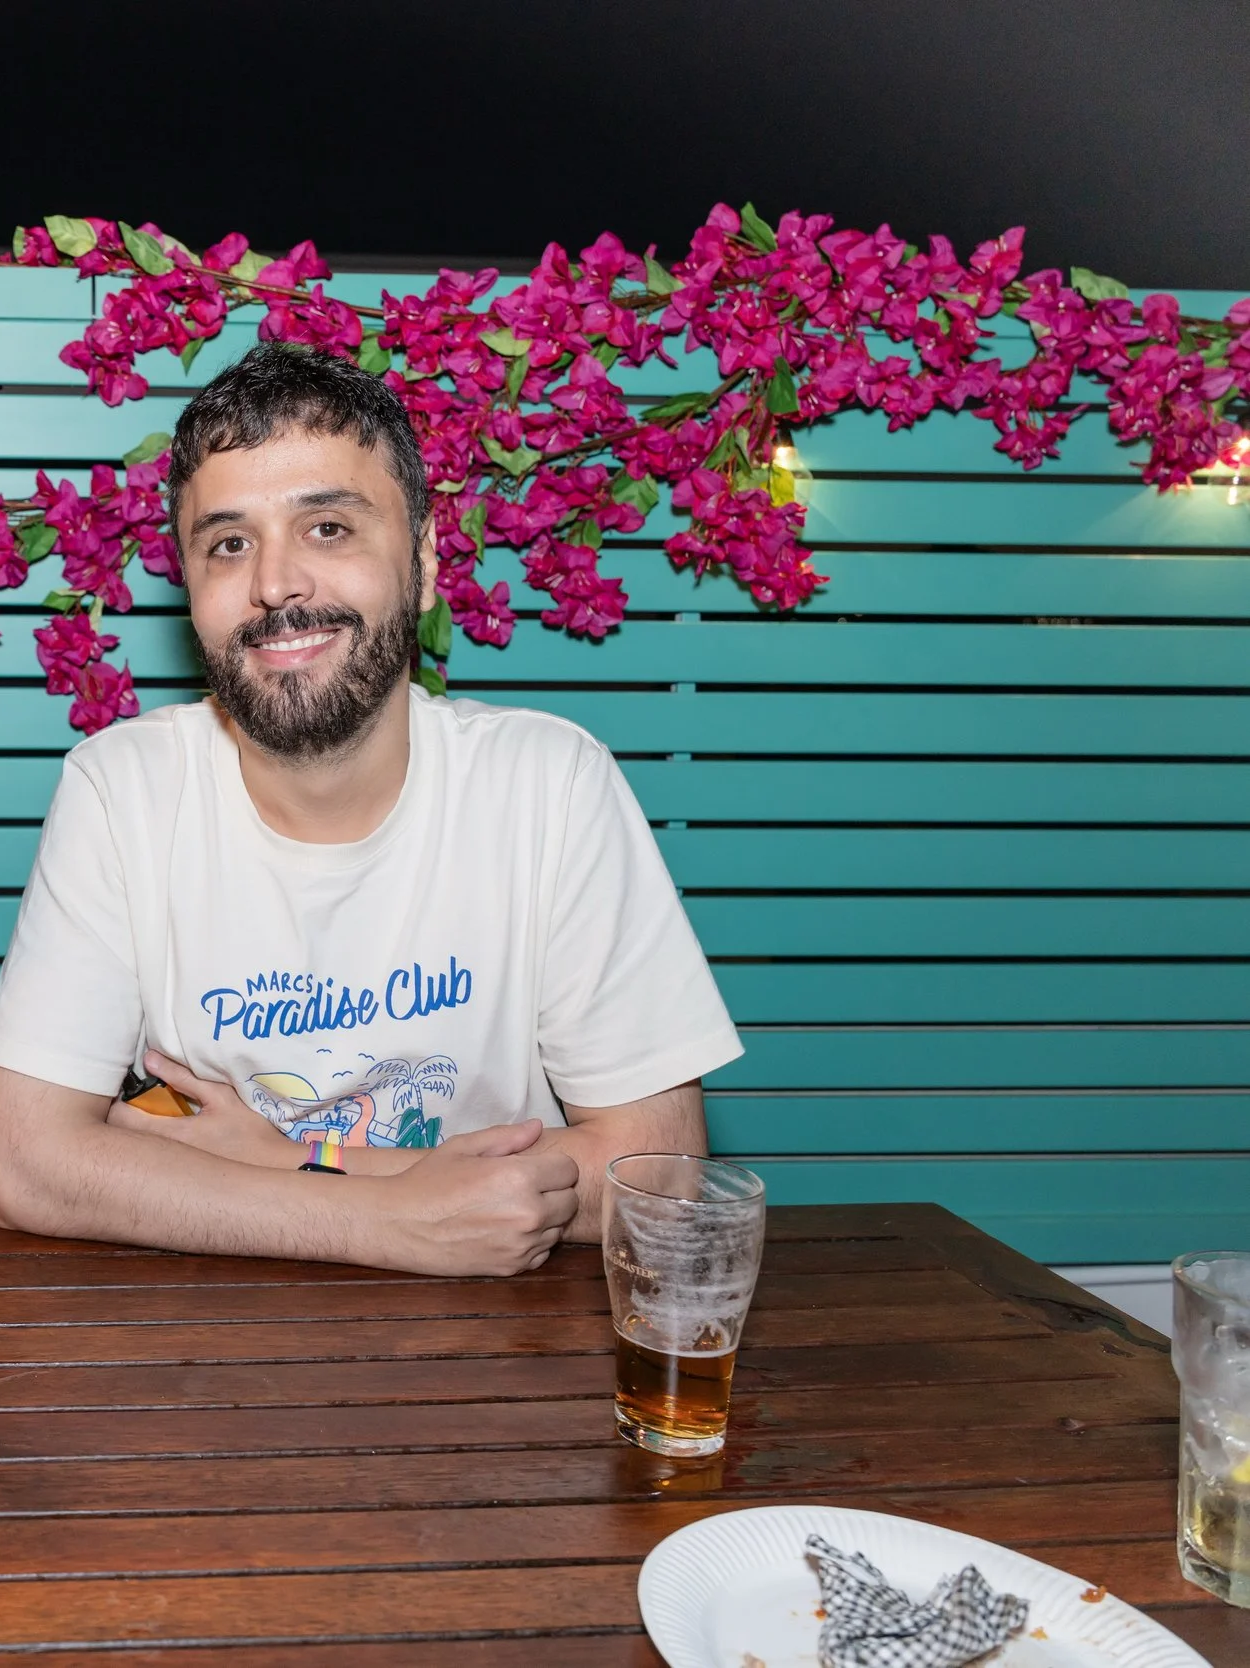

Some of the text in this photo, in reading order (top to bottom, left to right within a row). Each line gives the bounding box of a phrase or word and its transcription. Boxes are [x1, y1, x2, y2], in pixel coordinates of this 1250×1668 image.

[201, 956, 473, 1041] Paradise Club
[246, 970, 313, 996] MARCS
